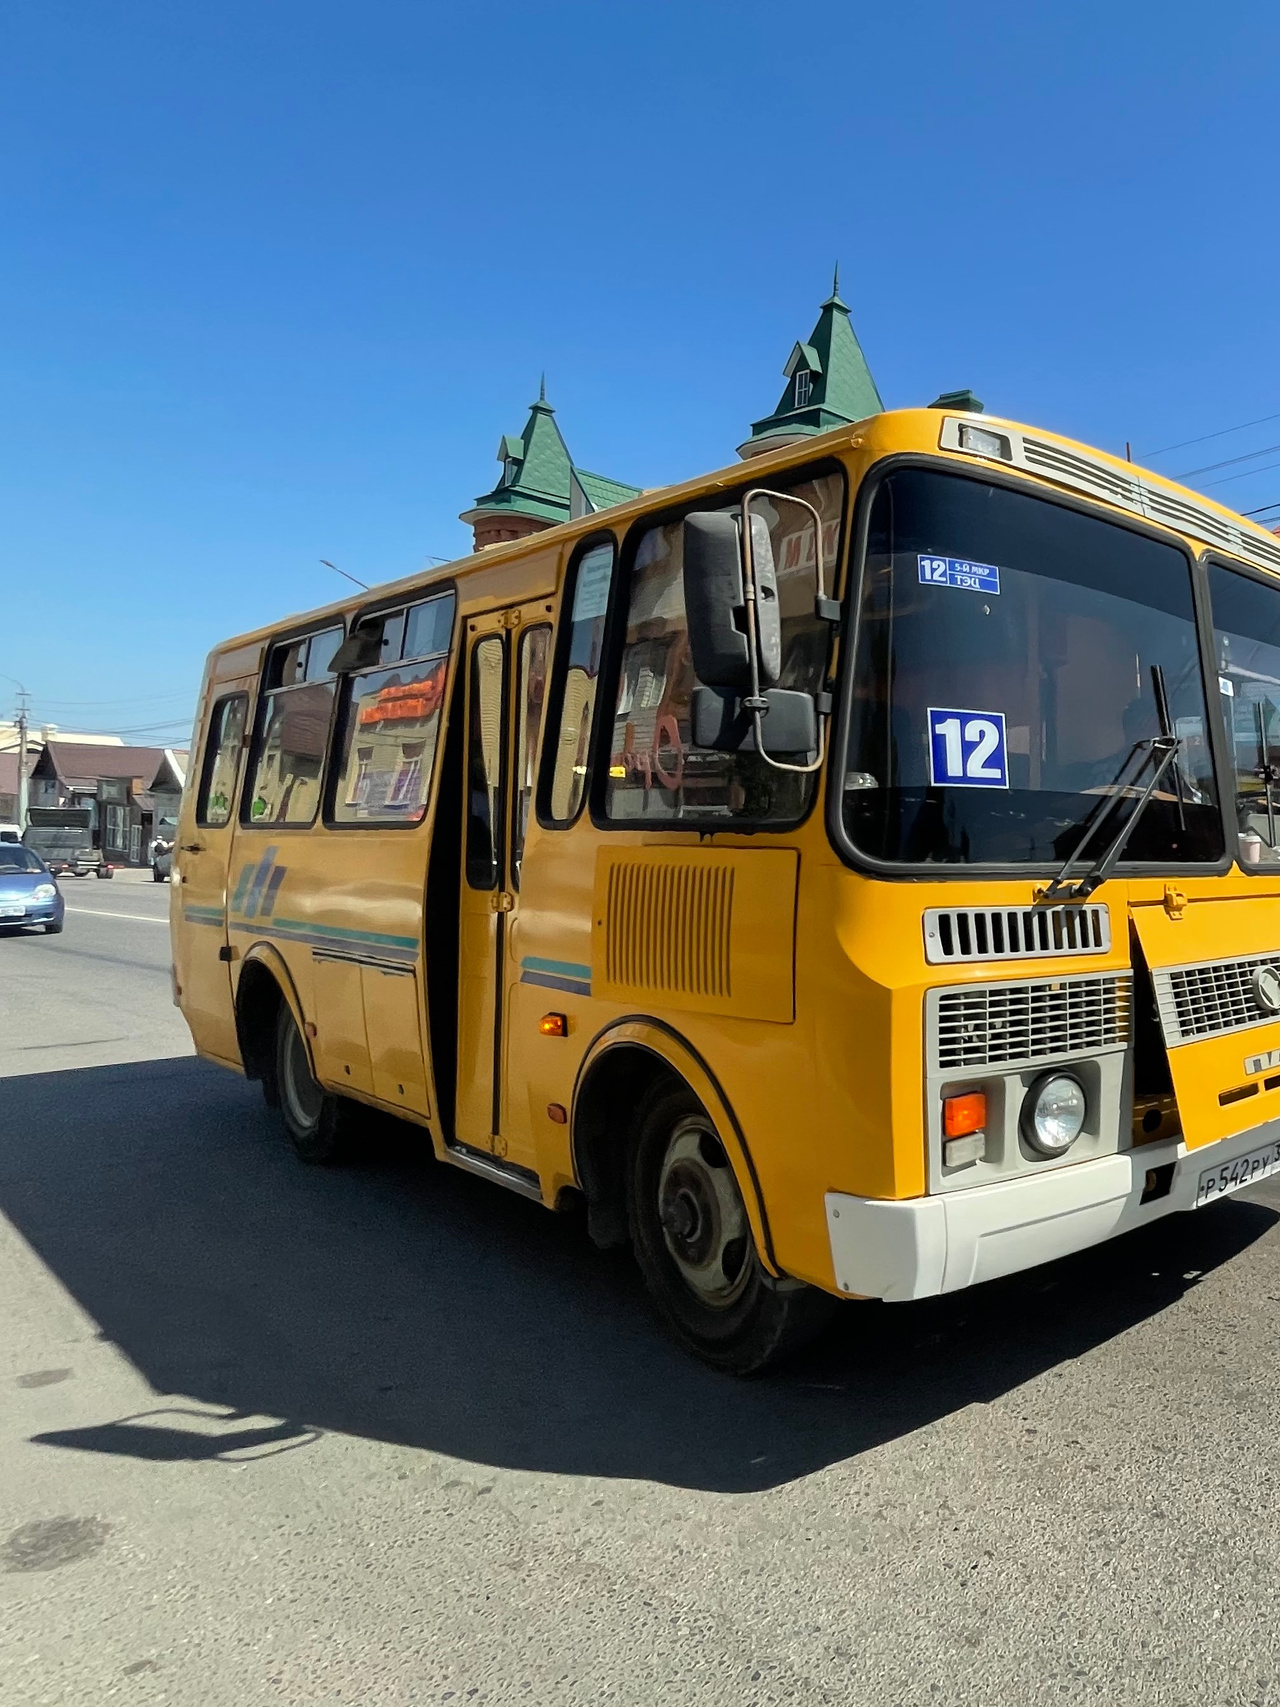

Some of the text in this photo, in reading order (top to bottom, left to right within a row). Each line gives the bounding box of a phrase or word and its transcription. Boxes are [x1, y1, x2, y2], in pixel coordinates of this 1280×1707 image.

[921, 560, 946, 581] 12
[971, 566, 990, 575] МКР
[955, 575, 980, 588] ТЭЦ
[935, 718, 1002, 779] 12
[1205, 1154, 1271, 1199] Р542РУ
